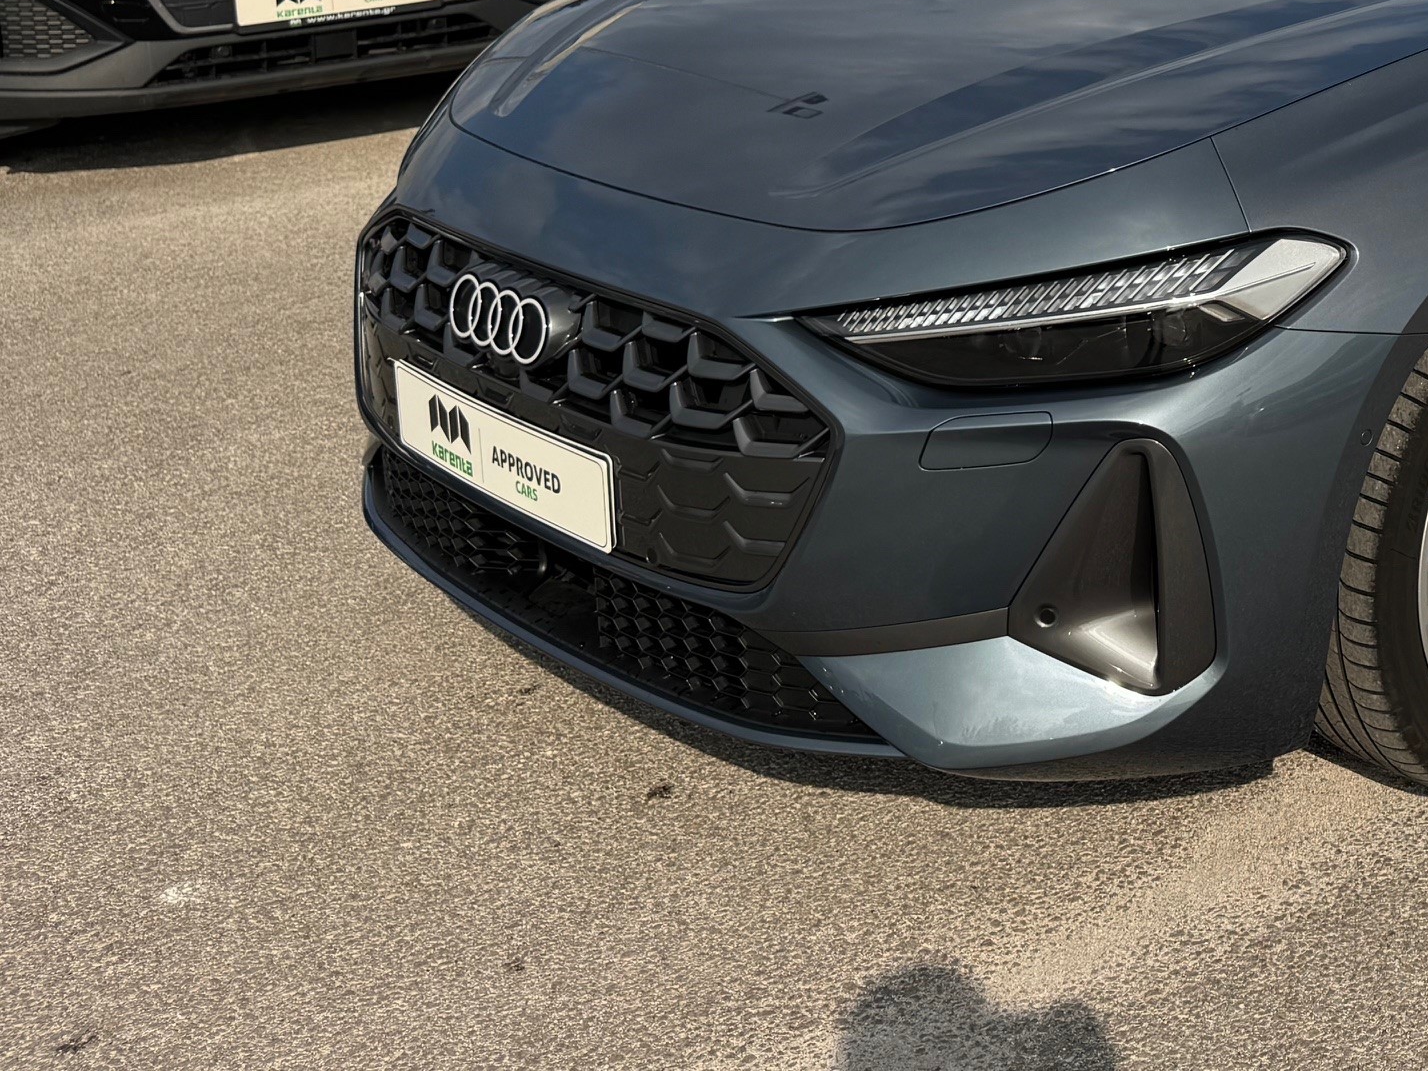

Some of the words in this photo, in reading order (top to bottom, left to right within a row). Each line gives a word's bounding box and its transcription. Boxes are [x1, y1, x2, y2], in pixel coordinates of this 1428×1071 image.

[432, 440, 474, 477] karenta
[492, 445, 562, 494] APPROVED
[515, 480, 539, 502] CARS
